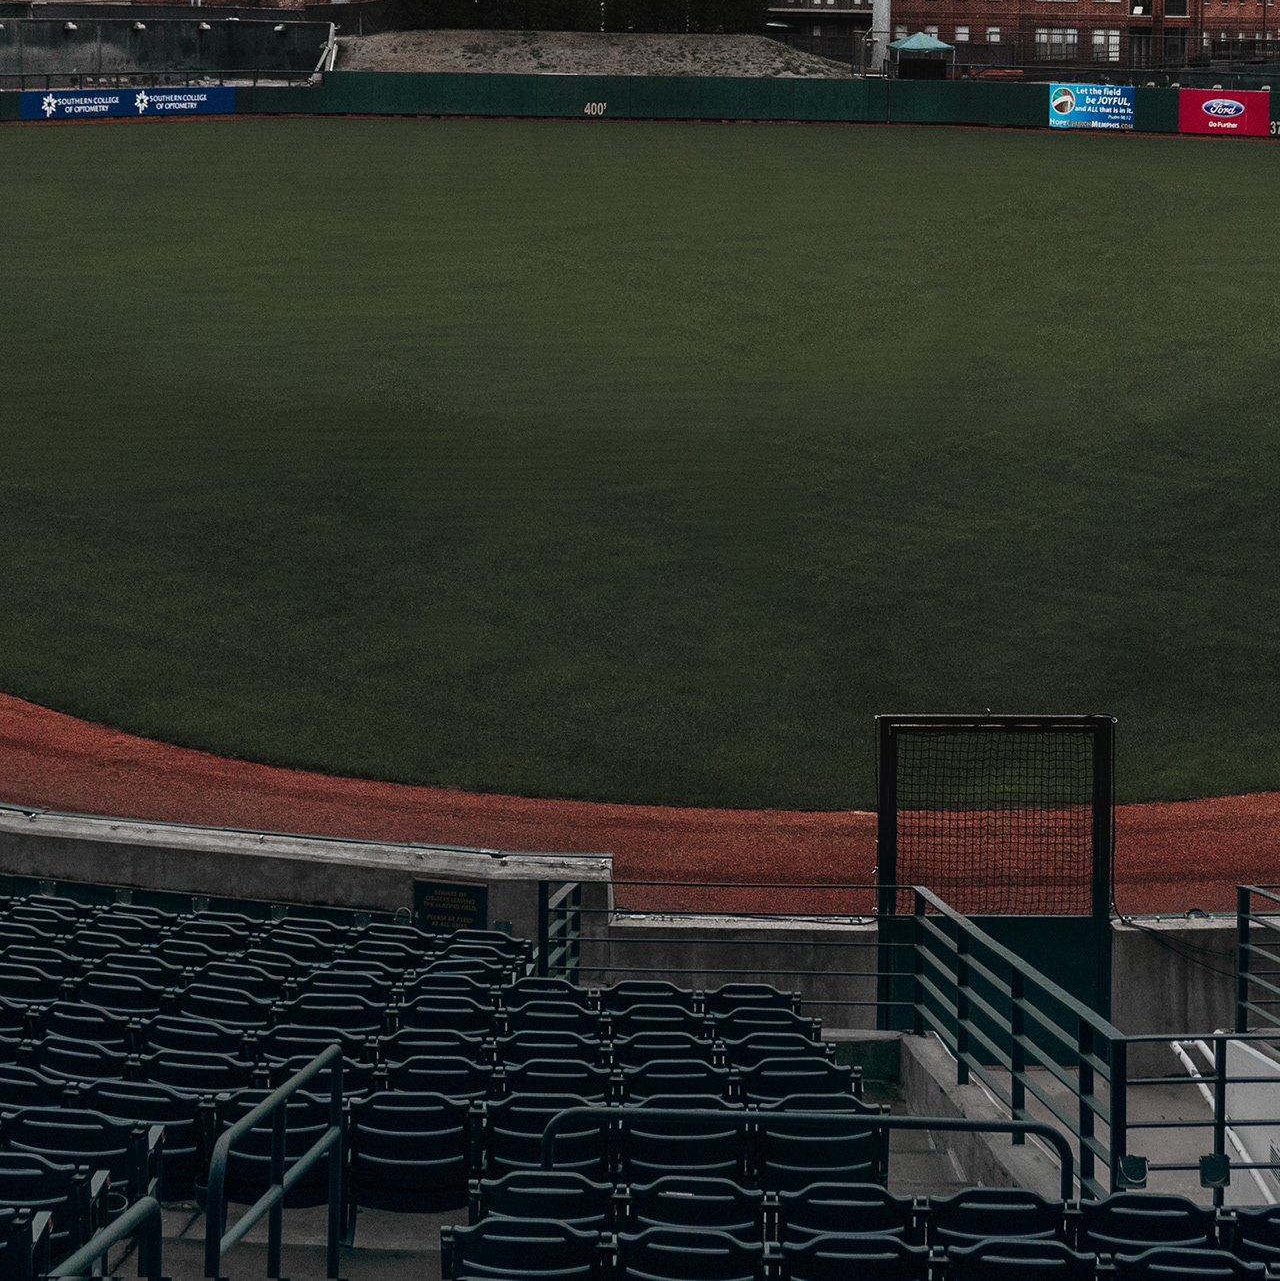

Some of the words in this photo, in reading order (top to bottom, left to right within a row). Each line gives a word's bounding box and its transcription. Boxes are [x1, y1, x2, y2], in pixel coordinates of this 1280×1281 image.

[1089, 87, 1102, 95] the
[1103, 88, 1121, 96] field
[57, 97, 92, 105] SOUTHERN
[93, 96, 119, 105] COLLEGE
[183, 94, 207, 102] COLLEGE
[1085, 96, 1096, 104] be
[1097, 96, 1131, 106] JOYFUL,
[74, 105, 109, 113] OPTOMETRY
[164, 102, 198, 110] OPTOMETRY
[1210, 102, 1237, 115] Ford
[1217, 121, 1238, 129] Further
